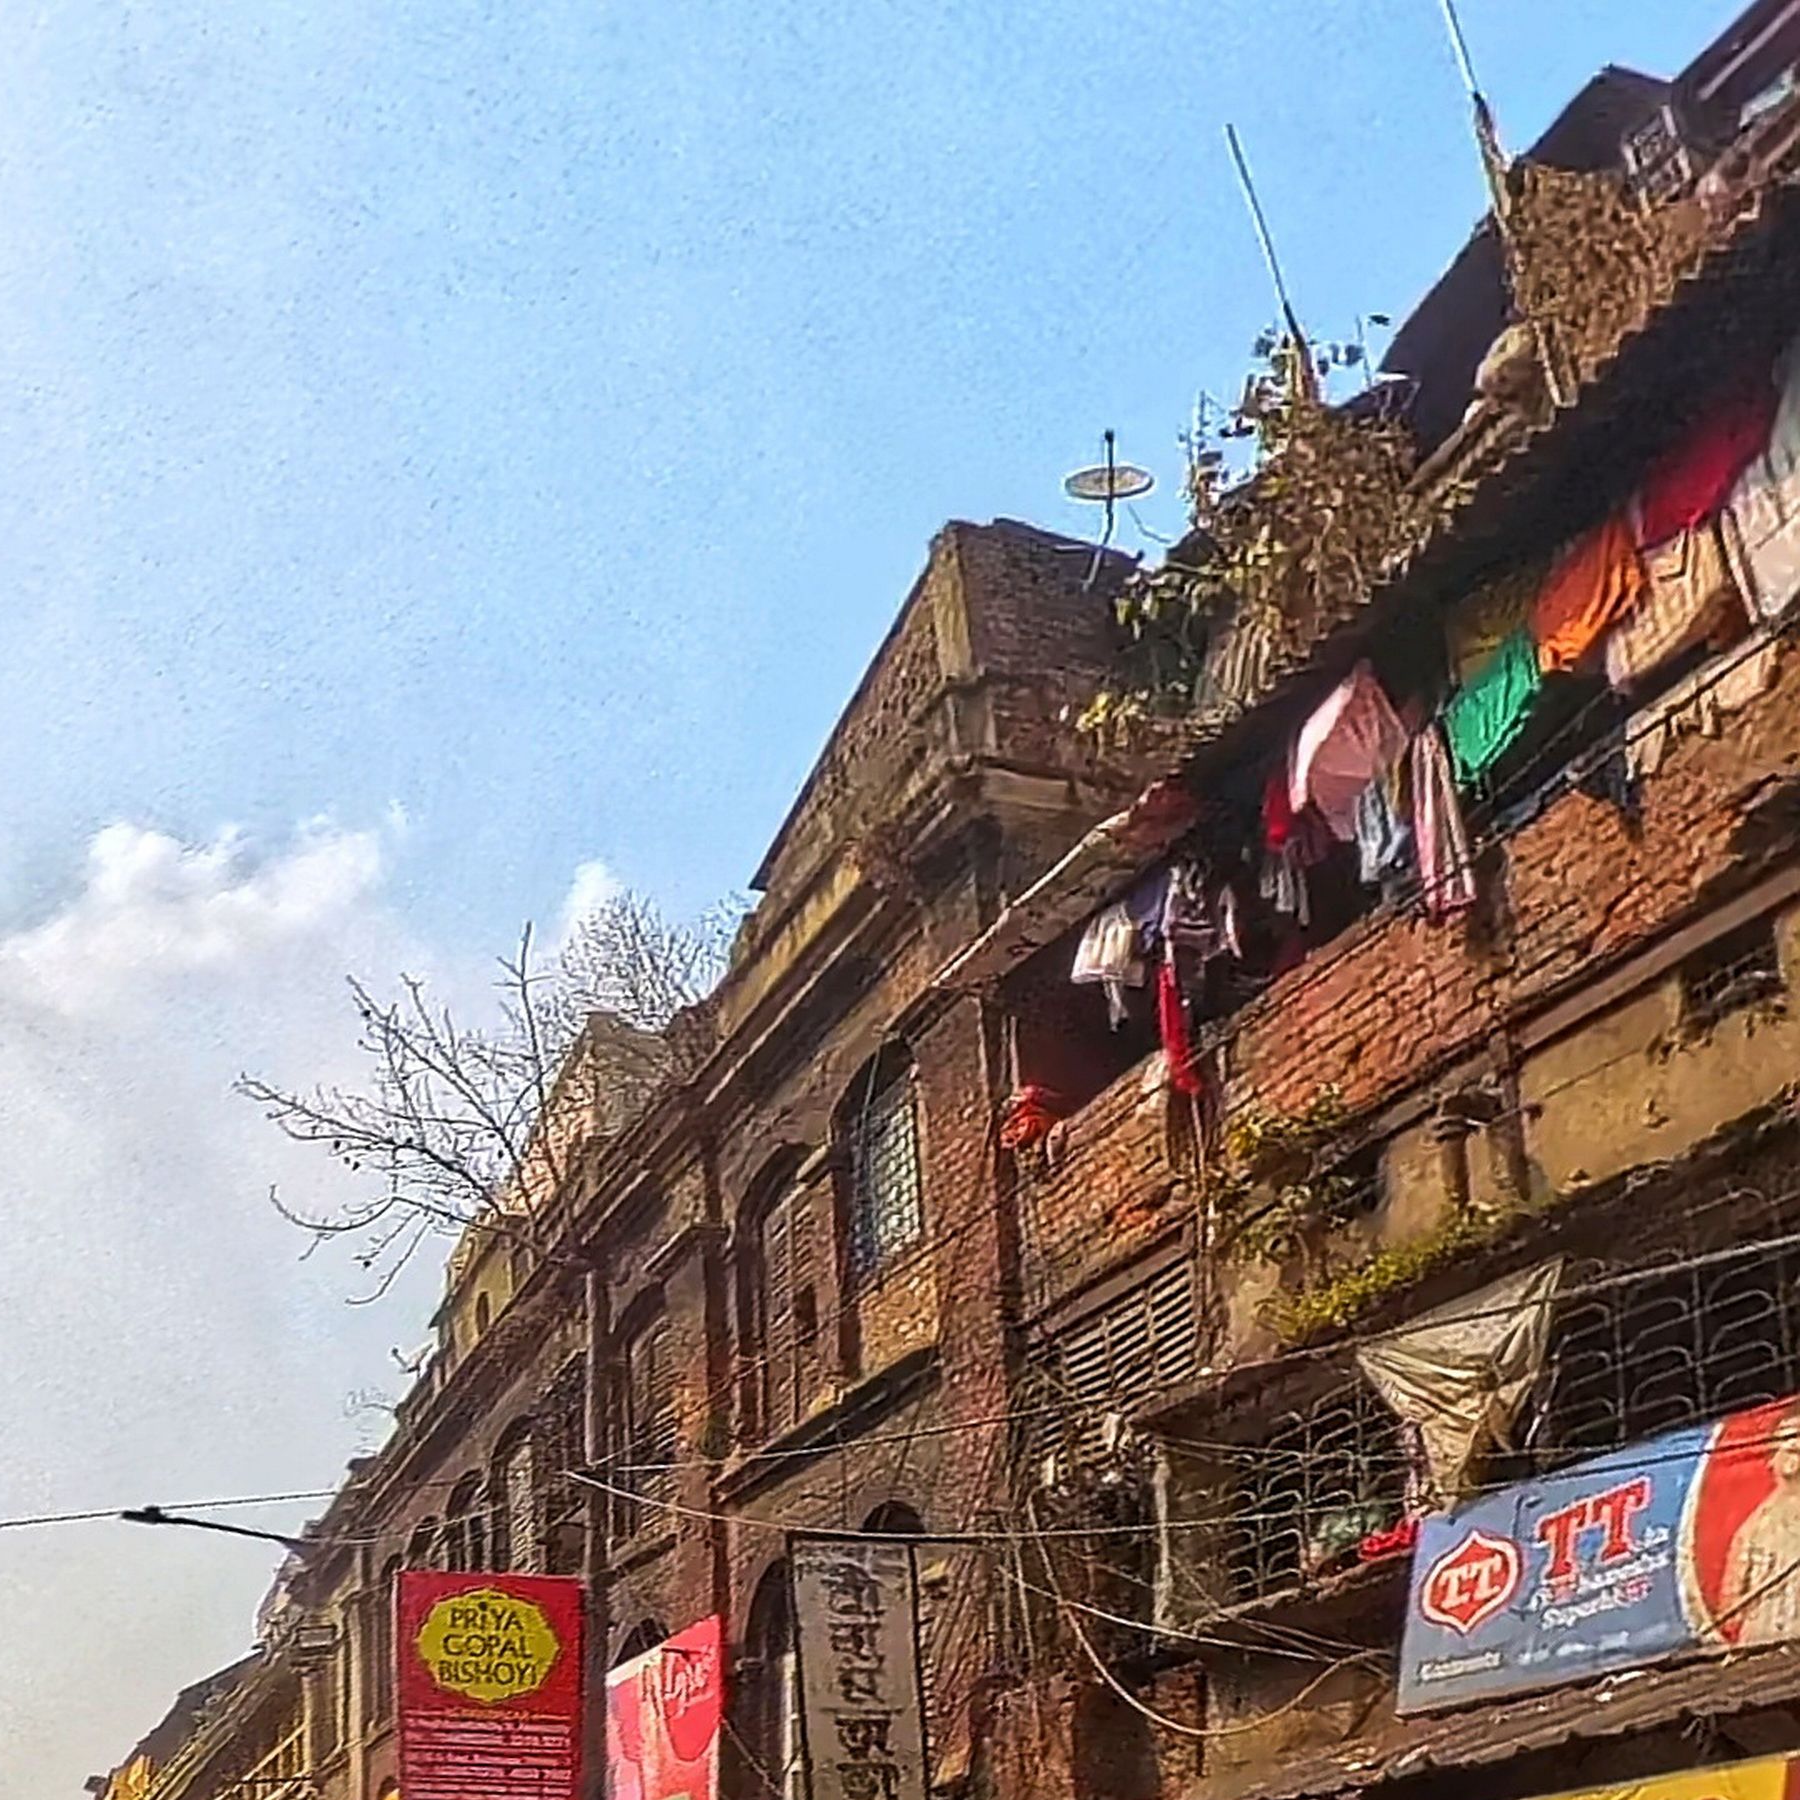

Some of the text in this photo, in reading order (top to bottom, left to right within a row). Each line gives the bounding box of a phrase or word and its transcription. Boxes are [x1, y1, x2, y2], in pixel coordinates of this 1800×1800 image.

[1535, 1474, 1653, 1581] TT
[1437, 1553, 1502, 1610] TT
[437, 1660, 538, 1686] BISHOYI
